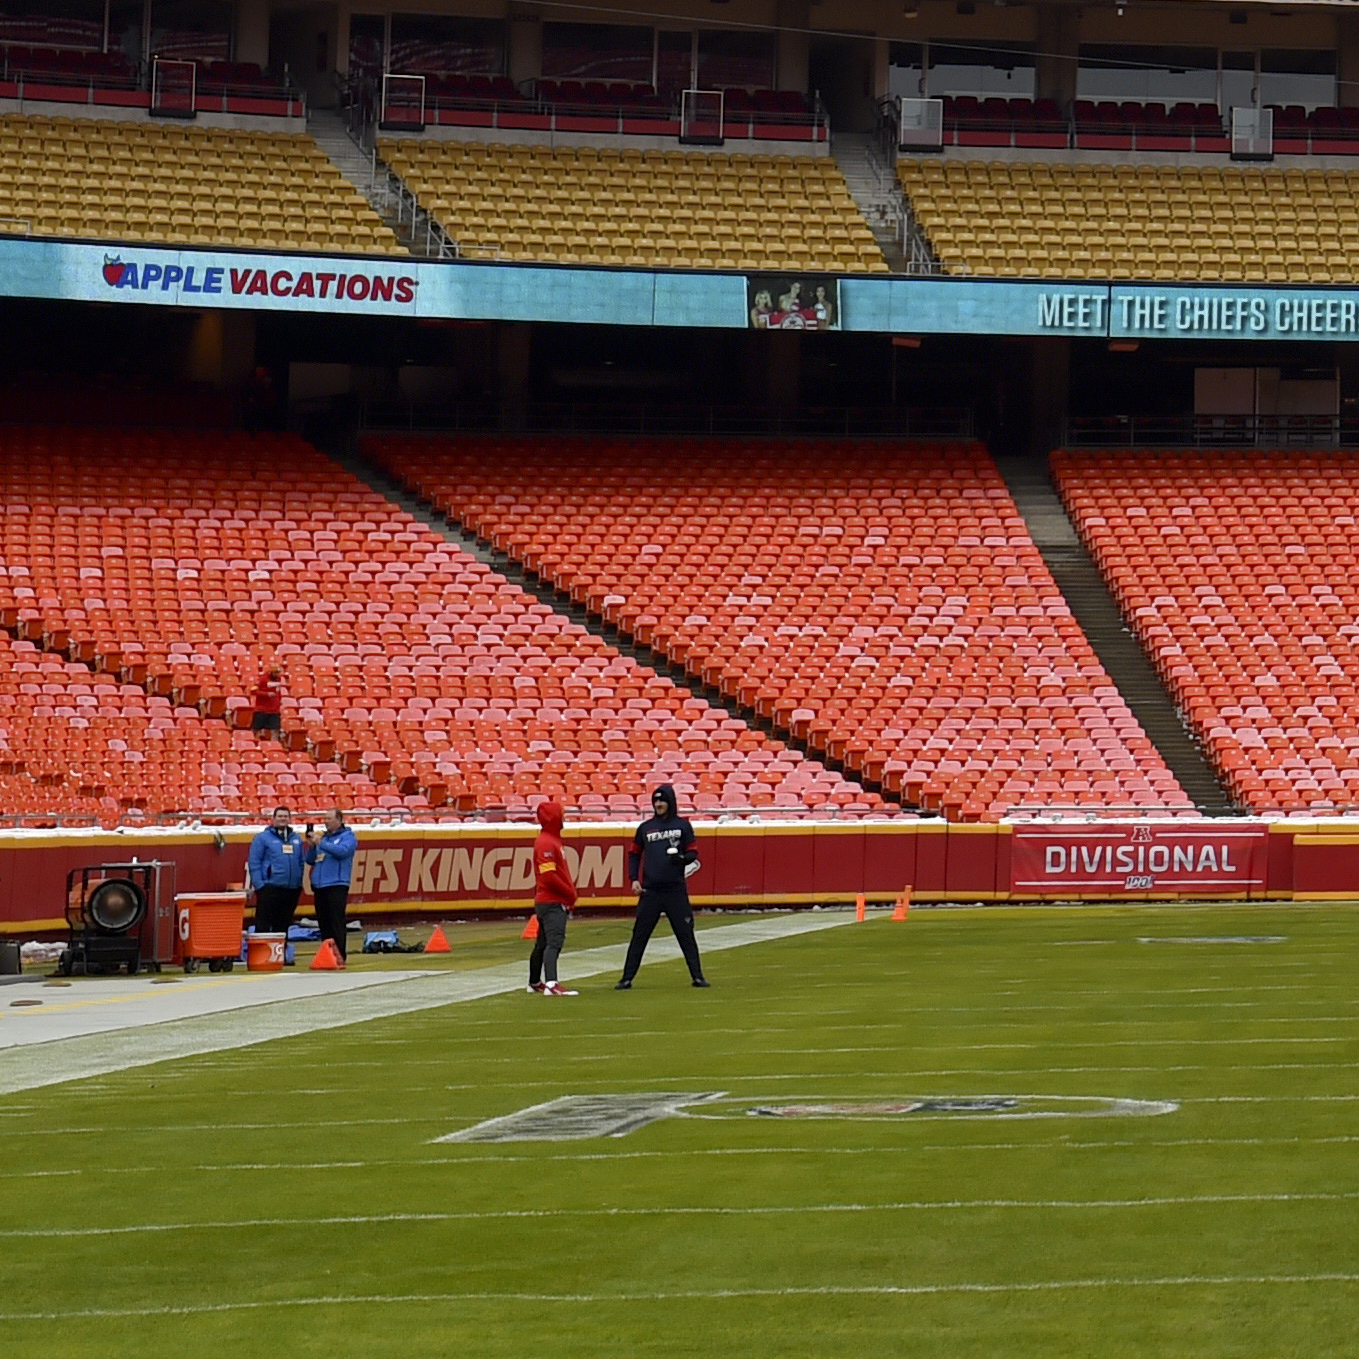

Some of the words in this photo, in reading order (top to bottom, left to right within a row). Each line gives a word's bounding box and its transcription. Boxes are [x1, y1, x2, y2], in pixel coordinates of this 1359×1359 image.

[119, 262, 225, 295] APPLE
[229, 268, 417, 305] VACATIONS
[1037, 293, 1107, 328] MEET
[1119, 295, 1168, 329] THE
[1175, 297, 1266, 332] CHIEFS
[1045, 844, 1237, 874] DIVISIONAL
